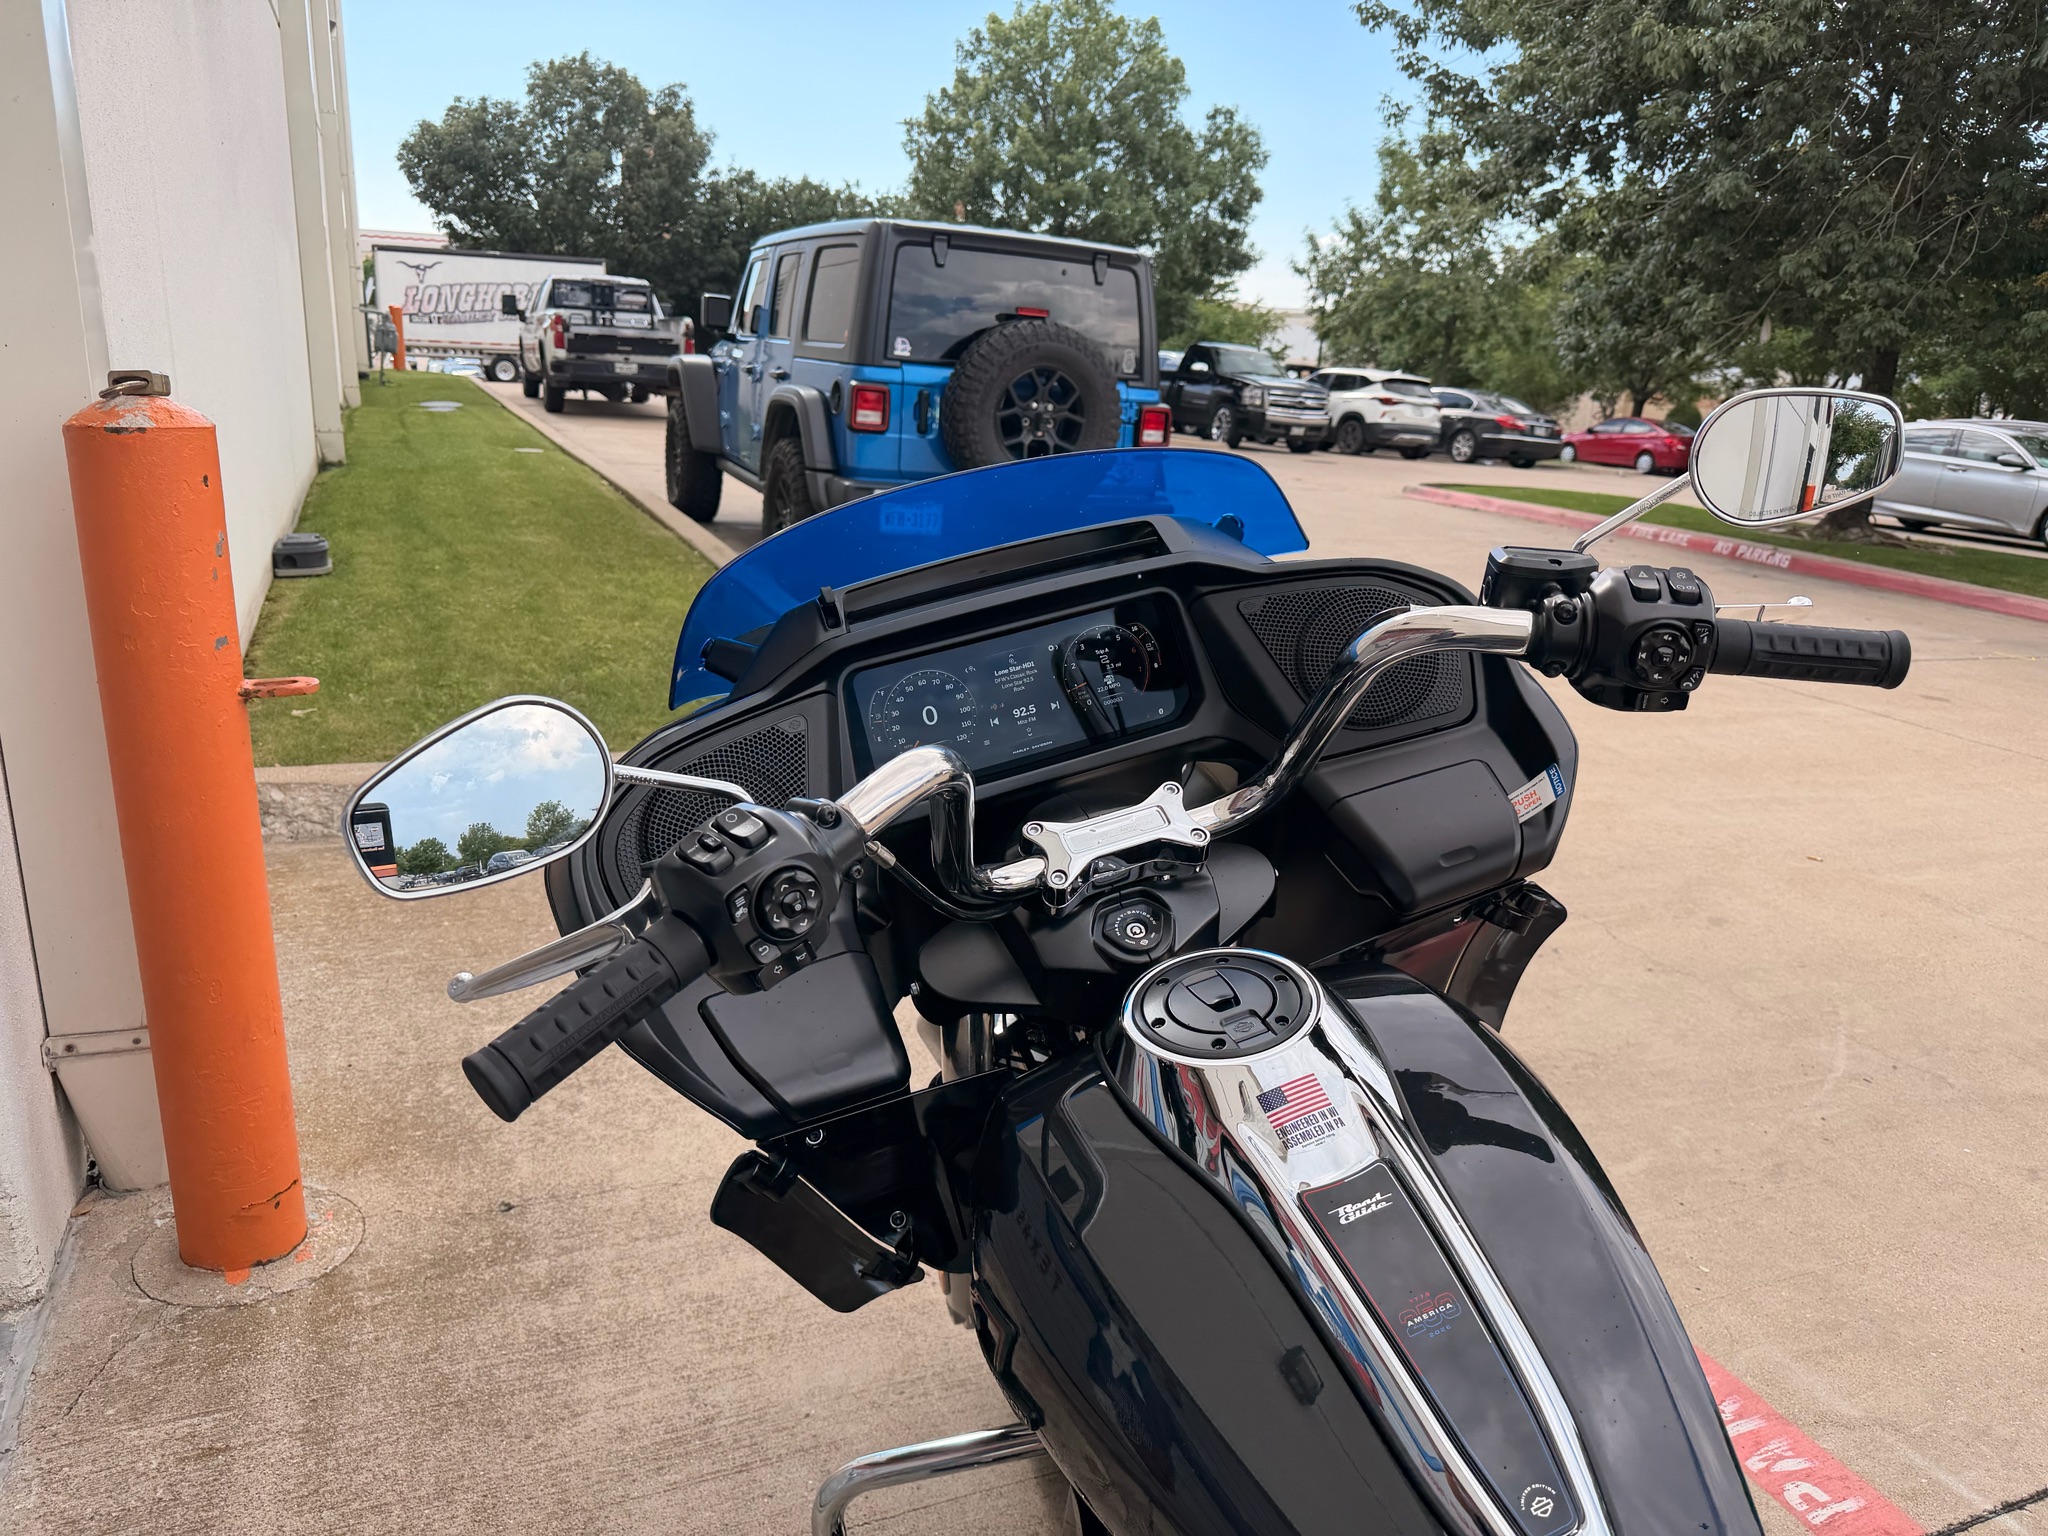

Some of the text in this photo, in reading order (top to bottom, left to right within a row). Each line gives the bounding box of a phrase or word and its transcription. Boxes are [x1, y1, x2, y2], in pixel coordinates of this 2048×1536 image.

[1713, 540, 1732, 556] NO
[1735, 543, 1792, 568] PARKING
[1071, 662, 1076, 670] 2
[1010, 672, 1026, 680] Classic
[1002, 682, 1013, 690] Lone
[1109, 682, 1120, 690] MPG
[922, 706, 938, 726] 0
[960, 706, 970, 714] 100
[1012, 704, 1036, 718] 92.5
[962, 720, 972, 728] 110
[956, 734, 968, 742] 120
[1549, 767, 1564, 795] NOTICE
[1512, 790, 1538, 807] PUSH
[1524, 796, 1542, 810] OPEN
[1274, 1106, 1340, 1140] ENGINEERED IN WI
[1282, 1124, 1326, 1151] ASSEMBLED
[1324, 1120, 1335, 1132] IN
[1335, 1116, 1346, 1129] PA
[1328, 1192, 1392, 1217] Road
[1340, 1201, 1393, 1225] Glide
[1407, 1302, 1453, 1327] AMERICA
[1428, 1324, 1452, 1338] 2026
[1520, 1484, 1556, 1511] LIMITED EDITION
